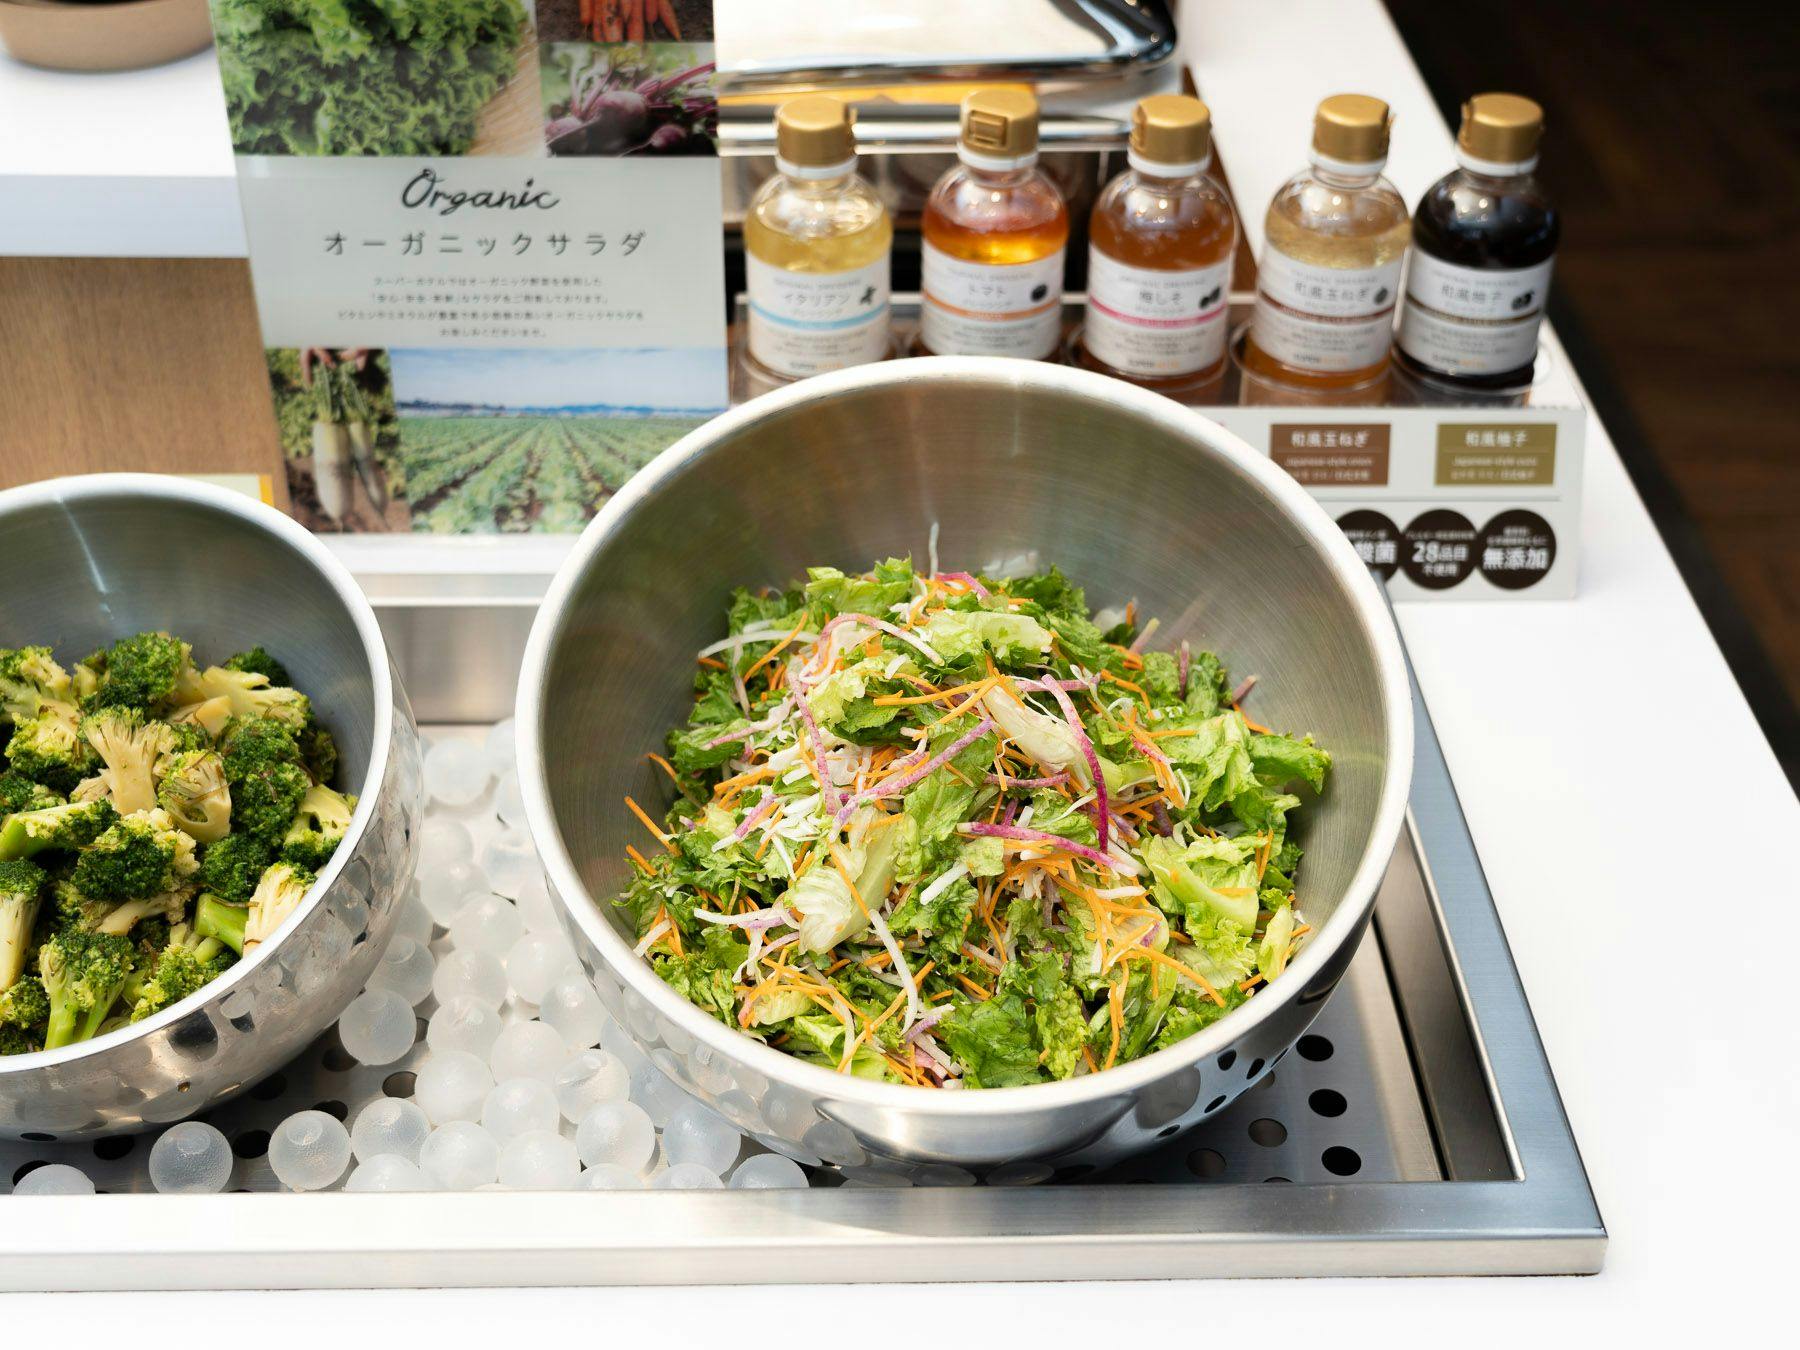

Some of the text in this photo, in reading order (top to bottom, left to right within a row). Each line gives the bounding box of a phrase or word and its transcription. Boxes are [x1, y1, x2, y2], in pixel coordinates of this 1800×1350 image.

[401, 168, 561, 216] Organic
[324, 230, 648, 256] オーガニックサラダ
[1290, 430, 1370, 448] 和風玉ねぎ
[1411, 540, 1468, 563] 28品目
[1481, 547, 1549, 571] 無添加
